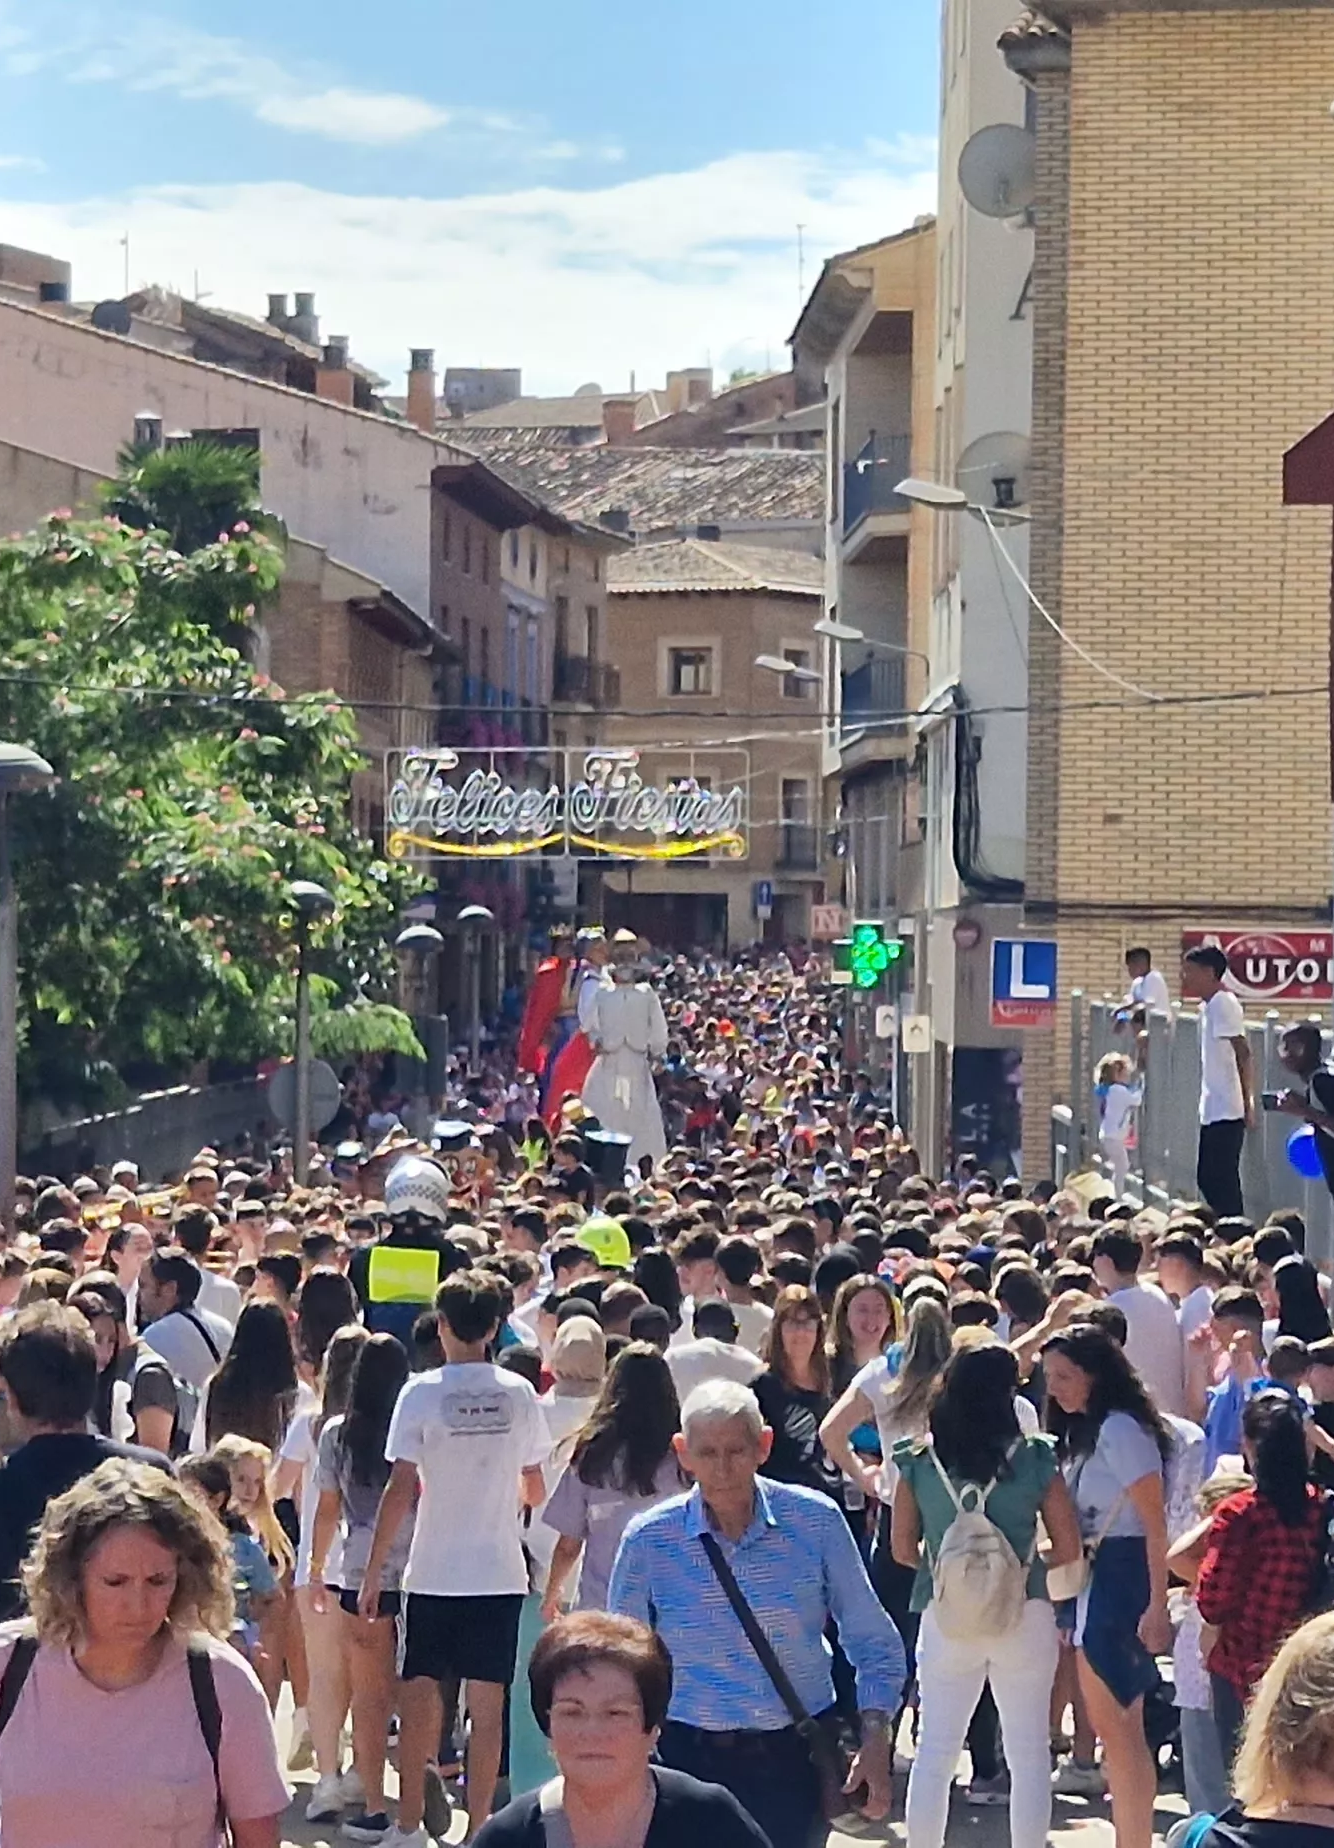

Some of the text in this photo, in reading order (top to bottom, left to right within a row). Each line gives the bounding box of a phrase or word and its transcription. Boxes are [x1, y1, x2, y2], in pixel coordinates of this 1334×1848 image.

[389, 748, 744, 836] Felices Fiestas
[1010, 943, 1050, 998] L
